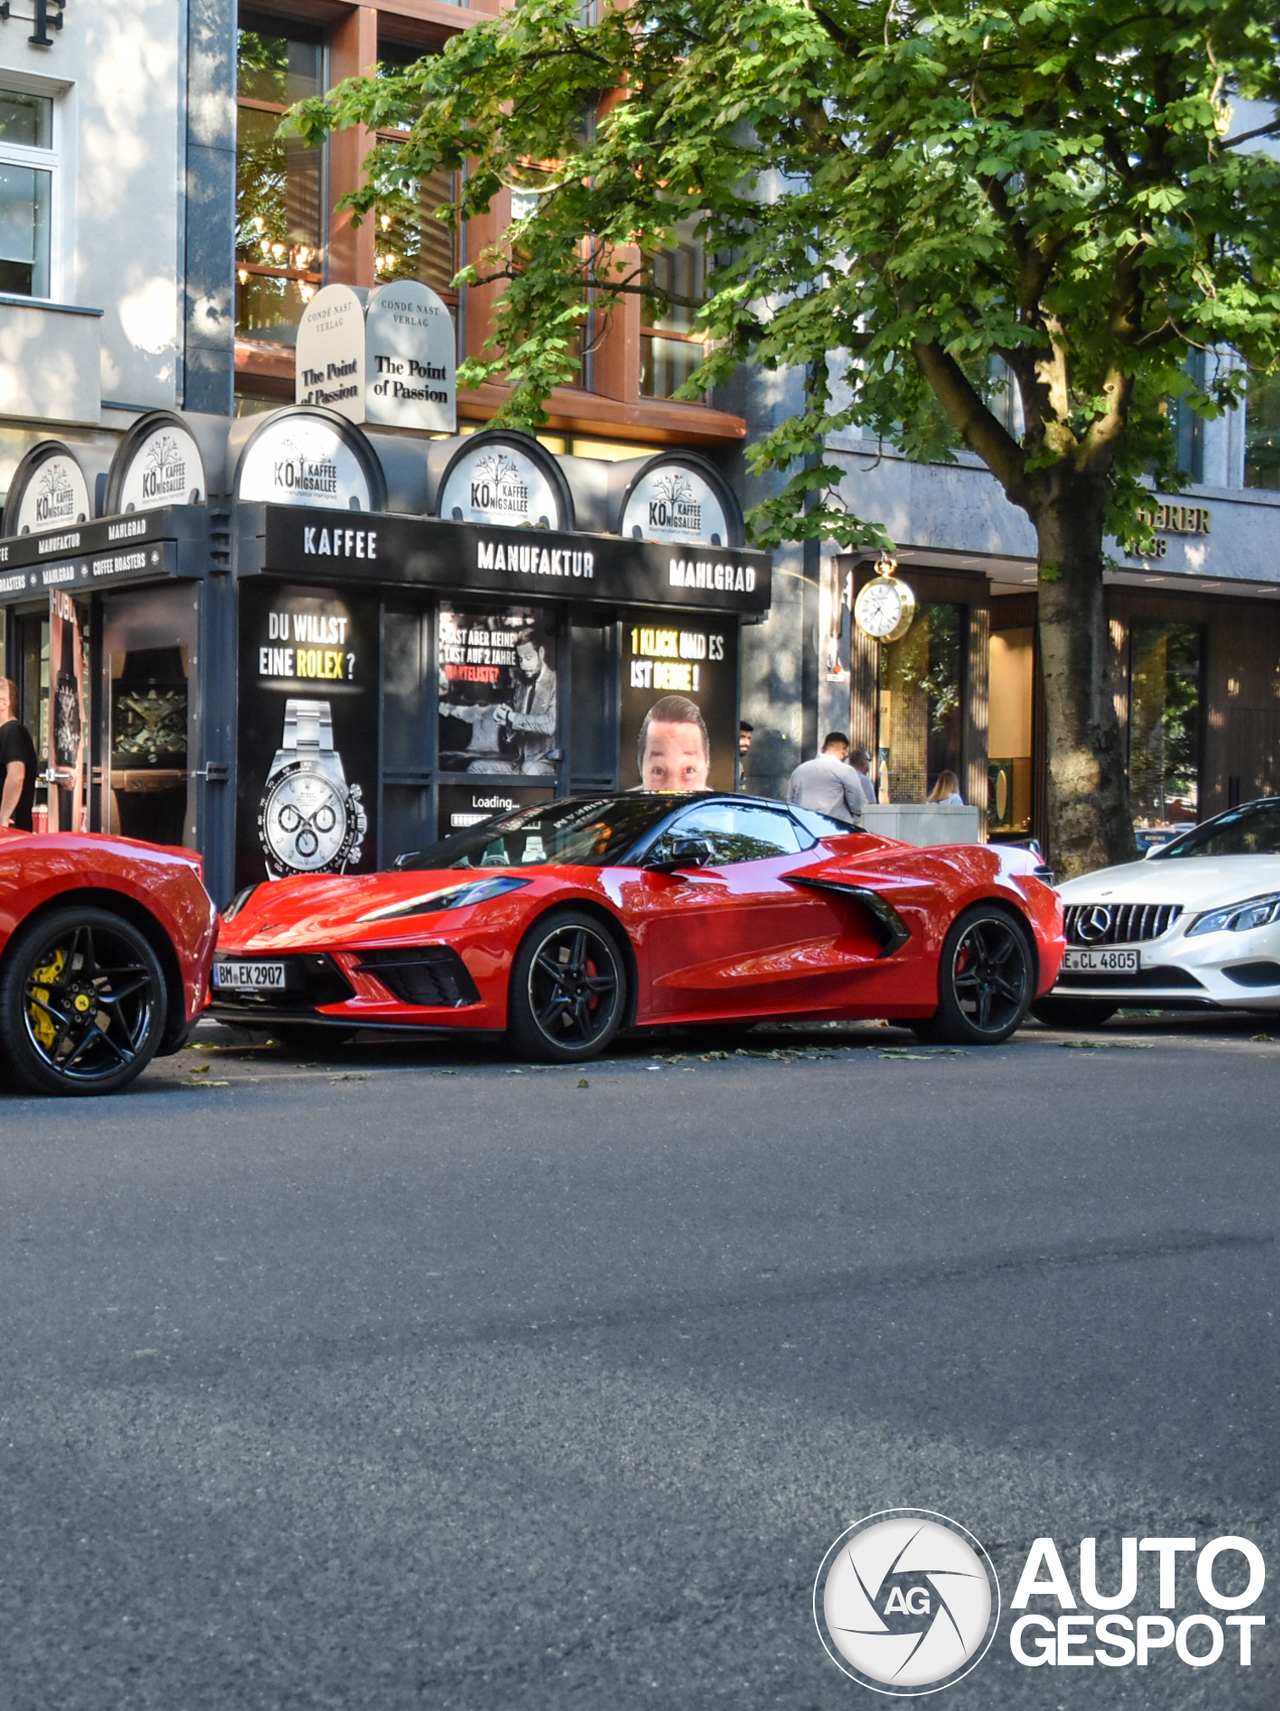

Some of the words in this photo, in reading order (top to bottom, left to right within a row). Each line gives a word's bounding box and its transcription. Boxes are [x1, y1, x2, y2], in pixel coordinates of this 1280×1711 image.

[307, 306, 332, 323] CONDÉ
[334, 302, 352, 315] NAST
[381, 300, 413, 313] CONDÉ
[416, 305, 439, 316] NAST
[316, 318, 344, 333] VERLAG
[393, 315, 429, 328] VERLAG
[302, 368, 324, 387] The
[327, 358, 357, 380] Point
[375, 355, 404, 375] The
[408, 359, 446, 381] Point
[315, 384, 358, 405] Passion
[373, 380, 389, 396] of
[393, 381, 448, 404] Passion
[308, 463, 337, 479] KAFFEE
[502, 484, 528, 499] KAFFEE
[677, 503, 701, 518] KAFFEE
[38, 533, 80, 554] MANUFAKTUR
[108, 519, 147, 541] MAHLGRAD
[93, 558, 114, 576] COFFEE
[114, 553, 146, 572] ROASTERS
[303, 526, 377, 561] KAFFEE
[477, 541, 595, 579] MANUFAKTUR
[669, 558, 756, 593] MAHLGRAD
[0, 575, 26, 593] ROASTERS
[42, 566, 75, 585] MAHLGRAD
[268, 612, 289, 641] DU
[293, 614, 347, 645] WILLST
[468, 630, 490, 647] ABER
[631, 627, 639, 655] 1
[640, 628, 679, 658] KLICK
[679, 630, 707, 660] UND
[708, 635, 724, 661] ES
[259, 647, 294, 677] EINE
[296, 649, 344, 679] ROLEX
[346, 652, 356, 680] ?
[444, 647, 466, 662] LUST
[467, 648, 483, 664] AUF
[484, 649, 491, 665] 2
[491, 650, 516, 666] JAHRE
[630, 660, 653, 689] IST
[692, 663, 700, 692] !
[1062, 953, 1072, 969] E
[1080, 953, 1097, 969] CL
[1100, 952, 1135, 969] 4805
[219, 966, 233, 984] BM
[239, 966, 253, 985] EK
[254, 966, 282, 985] 2907
